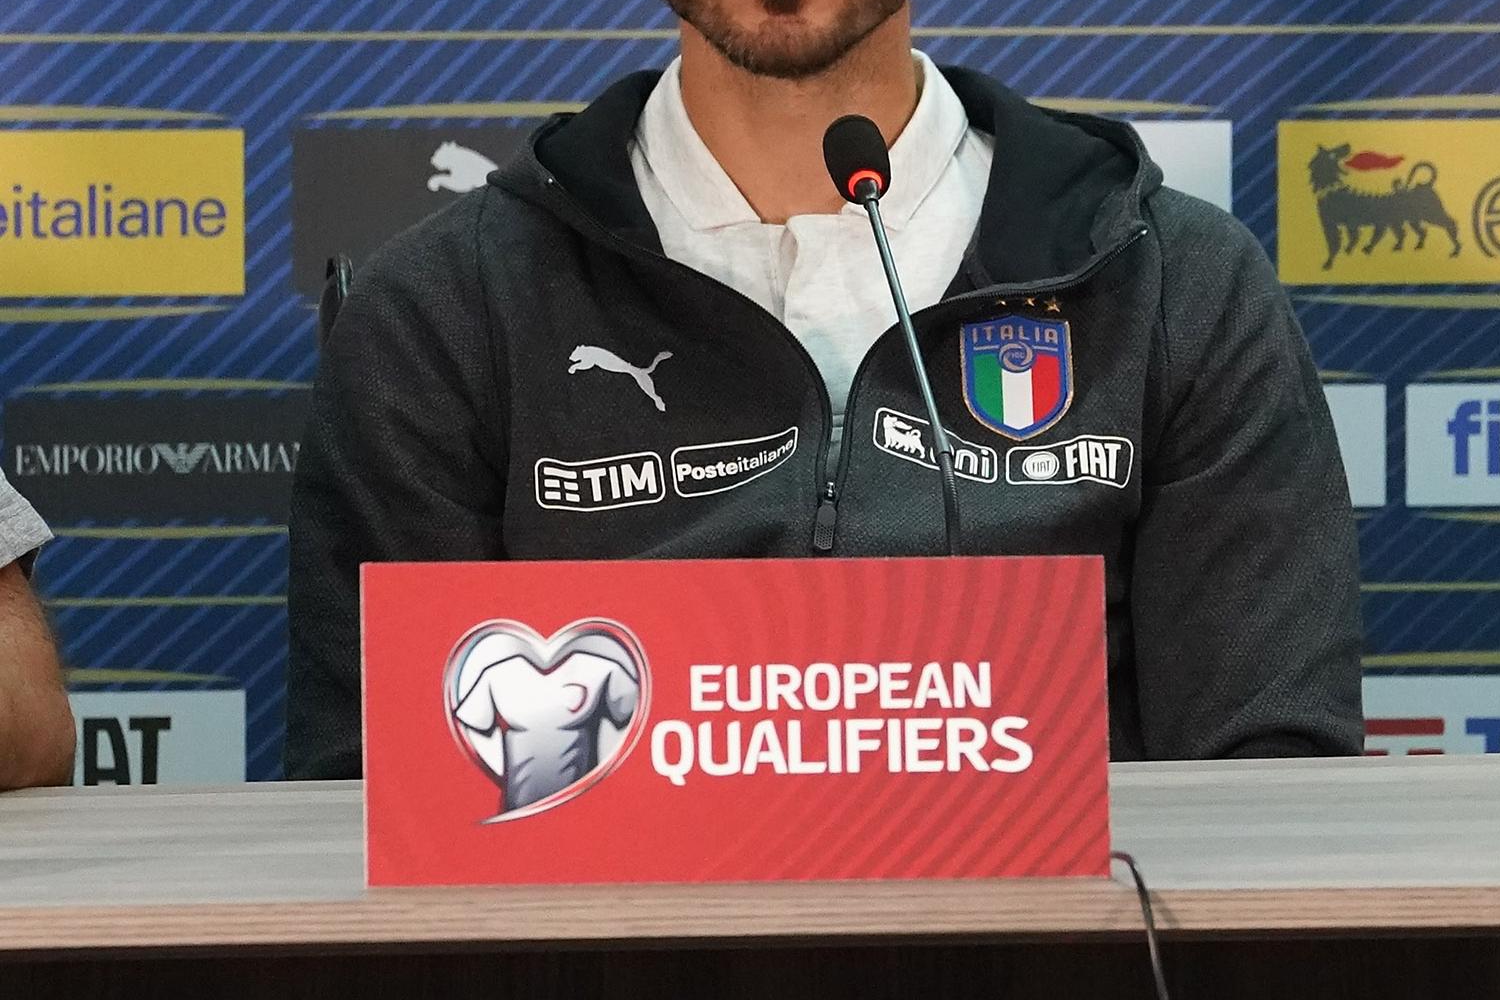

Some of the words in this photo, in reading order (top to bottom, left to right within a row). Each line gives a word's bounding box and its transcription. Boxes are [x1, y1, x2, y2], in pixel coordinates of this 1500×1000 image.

[0, 184, 227, 239] italiane
[972, 325, 1058, 344] ITALIA
[15, 443, 160, 475] EMPORIO
[202, 442, 300, 473] ARMA
[583, 461, 657, 501] TIM
[1065, 440, 1122, 479] FIAT
[690, 662, 992, 712] EUROPEAN
[83, 716, 171, 786] AT
[650, 716, 1034, 786] QUALIFIERS
